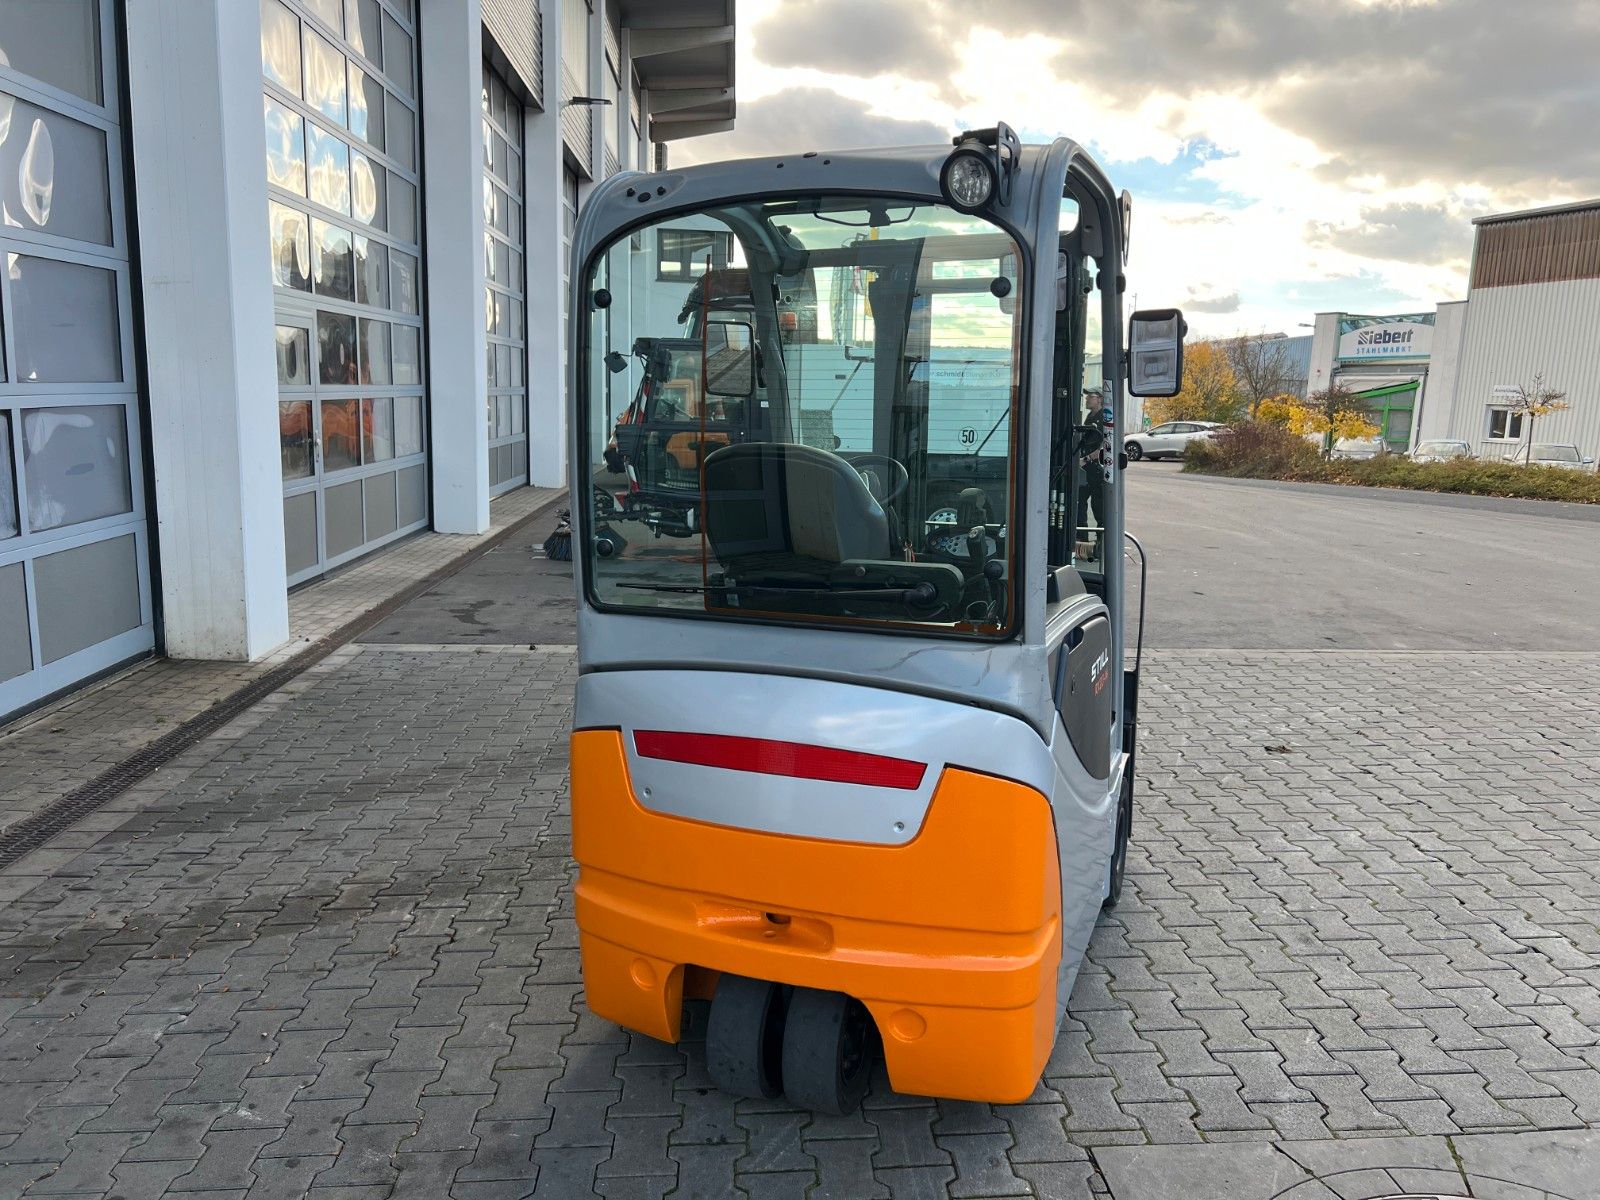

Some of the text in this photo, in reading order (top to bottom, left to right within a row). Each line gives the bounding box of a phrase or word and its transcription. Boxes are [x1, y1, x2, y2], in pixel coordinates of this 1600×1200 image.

[1357, 329, 1414, 345] Siebert
[1356, 346, 1412, 355] STAHLMARKT
[961, 429, 975, 444] 50
[1091, 647, 1109, 683] STILL
